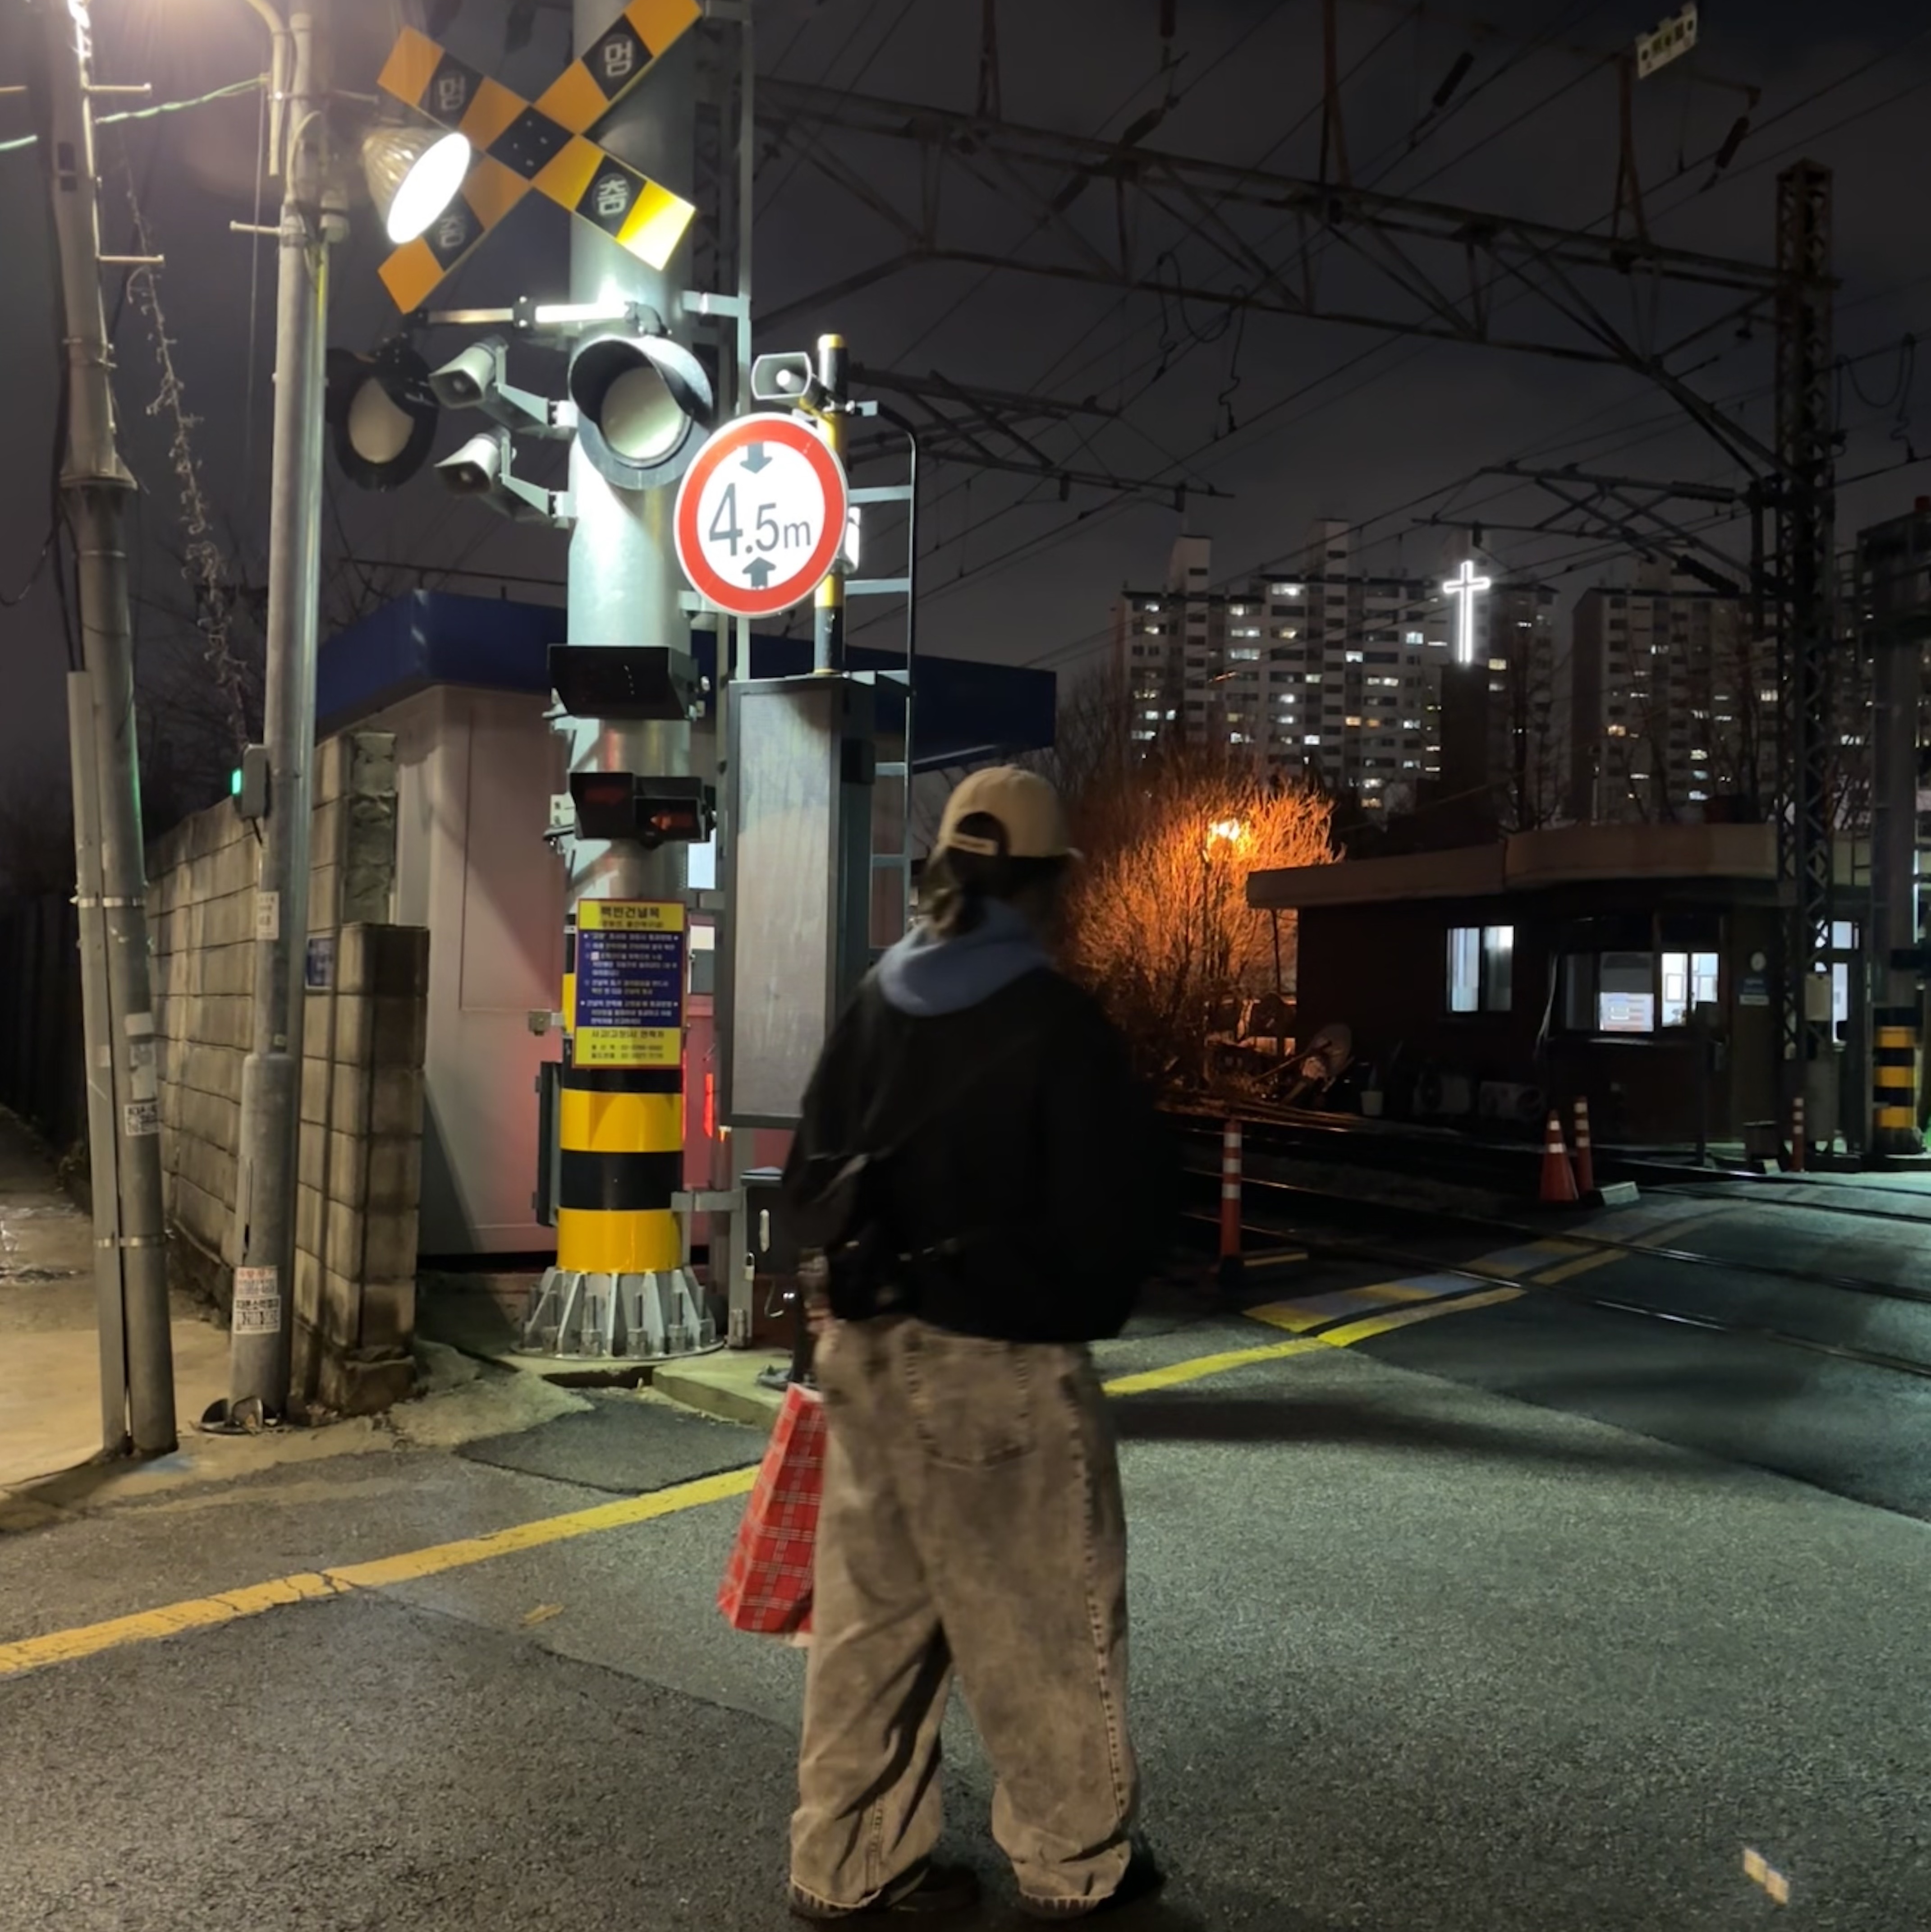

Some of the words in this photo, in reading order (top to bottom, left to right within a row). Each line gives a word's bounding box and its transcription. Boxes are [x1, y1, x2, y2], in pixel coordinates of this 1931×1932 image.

[605, 40, 632, 78] 멈
[439, 75, 466, 111] 멈
[598, 179, 628, 216] 춤
[709, 482, 811, 556] 4.5m
